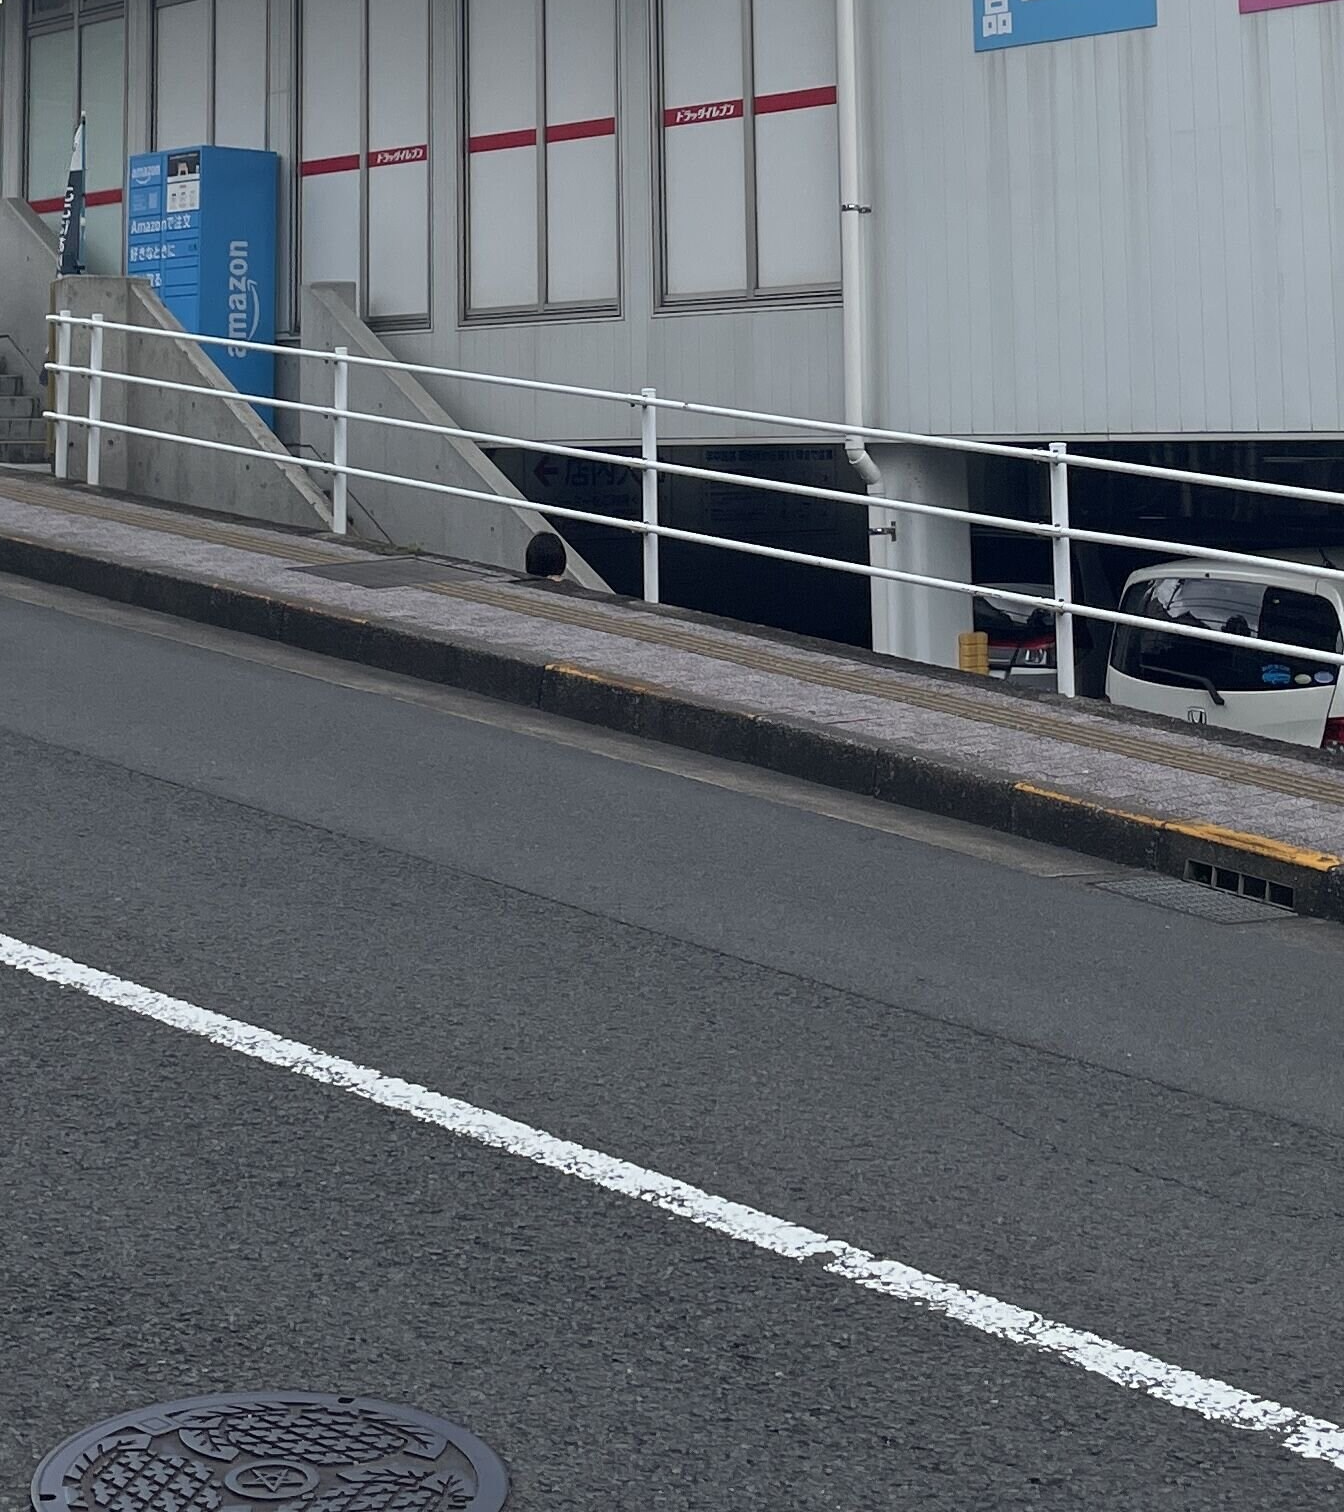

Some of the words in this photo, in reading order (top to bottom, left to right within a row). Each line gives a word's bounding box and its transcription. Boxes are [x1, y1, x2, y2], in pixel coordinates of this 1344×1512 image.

[676, 103, 735, 123] ドラッグイレブン
[227, 240, 249, 359] amazon
